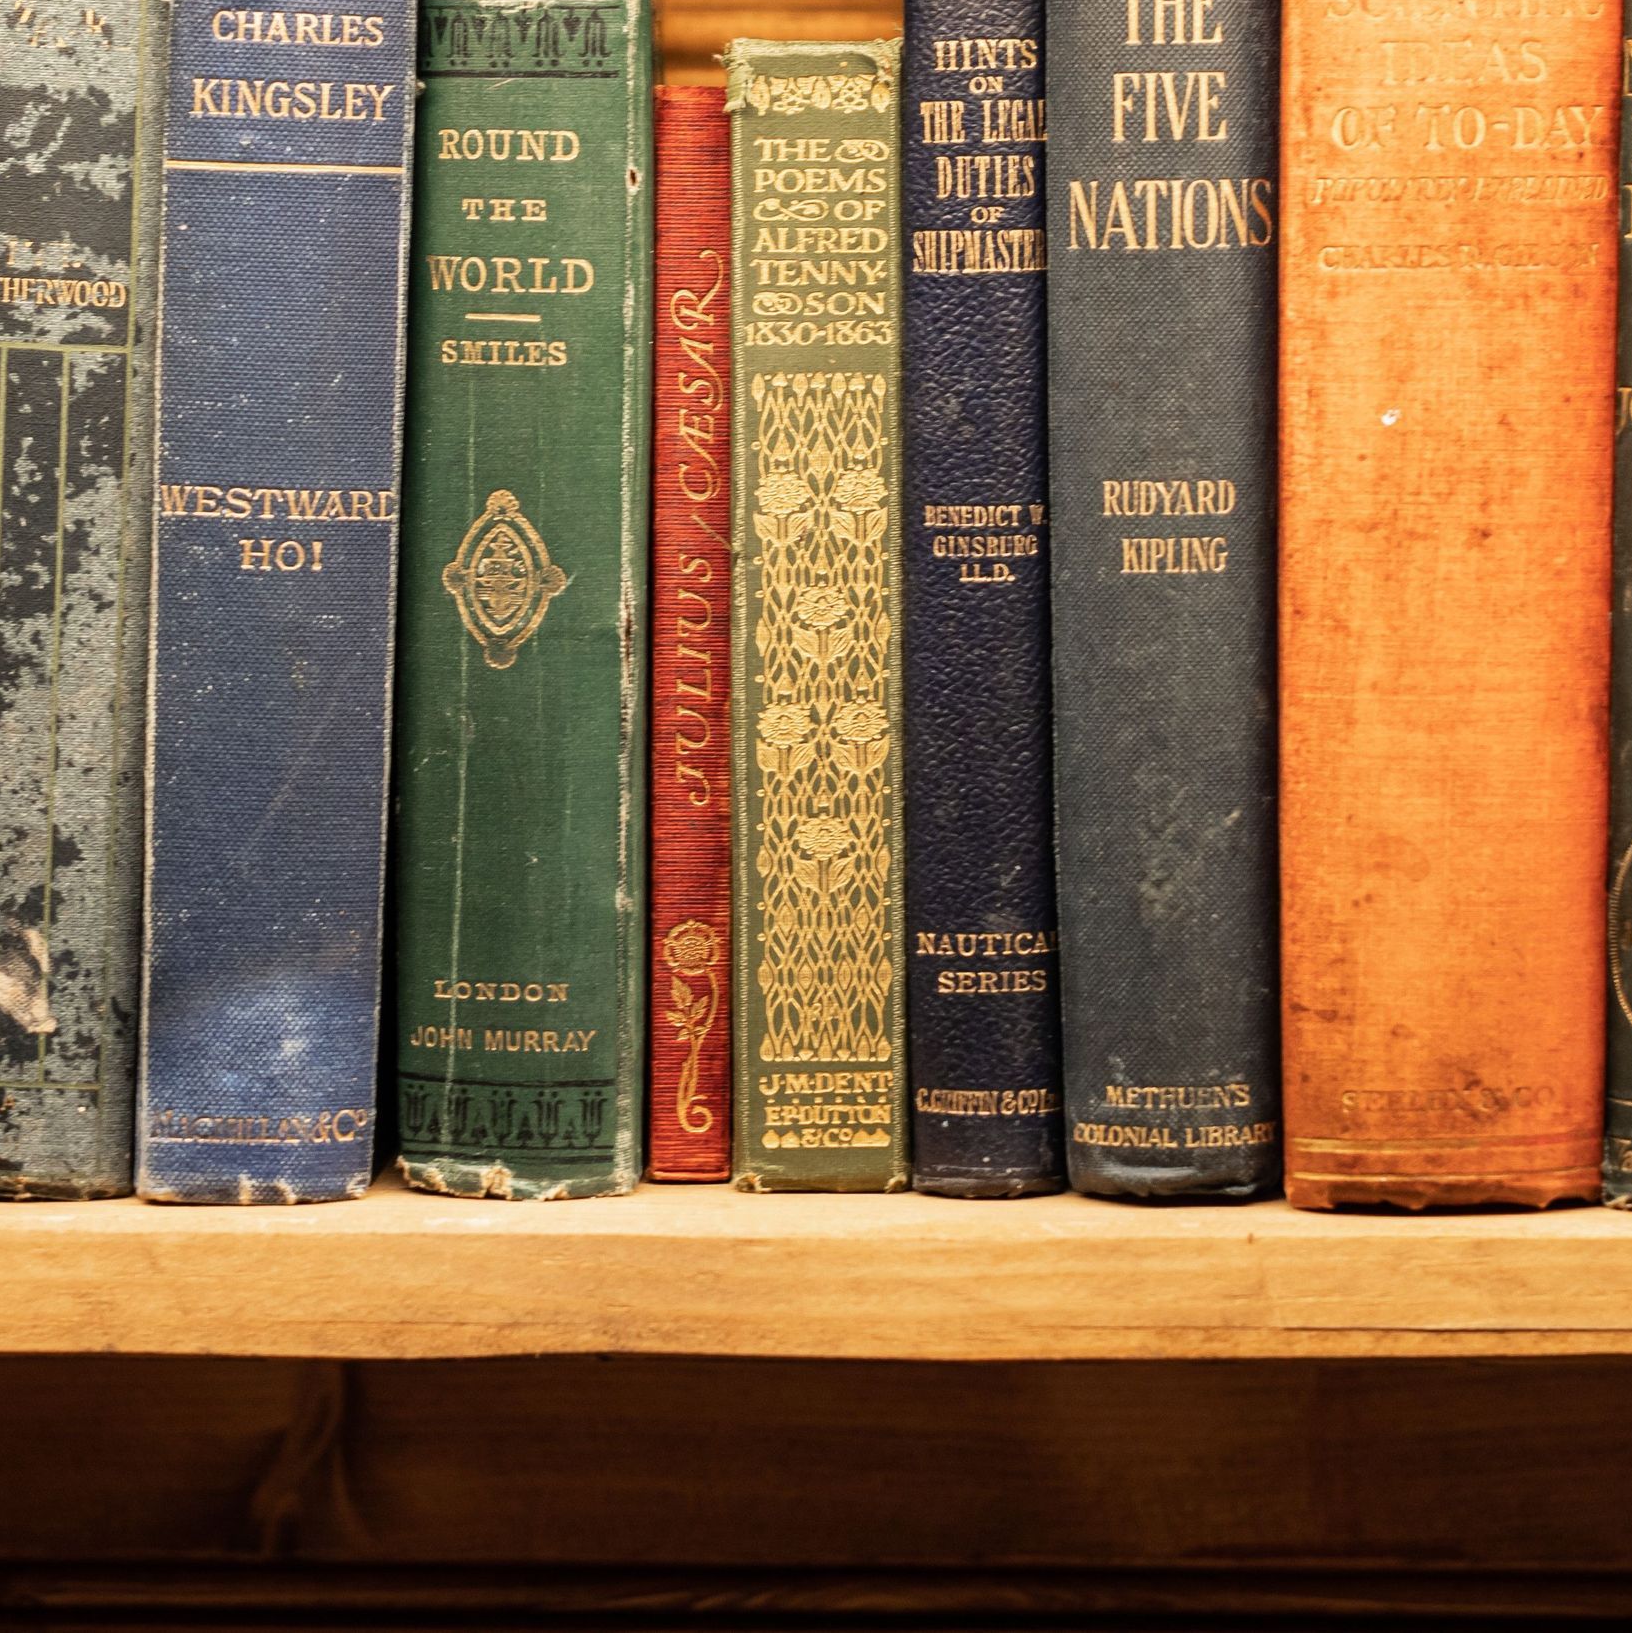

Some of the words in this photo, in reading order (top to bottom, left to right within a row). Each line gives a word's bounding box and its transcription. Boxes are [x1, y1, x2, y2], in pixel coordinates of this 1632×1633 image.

[212, 10, 384, 47] CHARLES
[933, 39, 1038, 70] HINTS
[1379, 36, 1549, 87] IDEAS
[969, 76, 1004, 94] ON
[189, 77, 396, 121] KINGSLEY
[1112, 71, 1228, 143] FIVE
[920, 100, 966, 143] THE
[1330, 105, 1398, 151] OF
[1415, 103, 1607, 151] TO-DAY
[438, 129, 580, 161] ROUND
[754, 139, 832, 162] THE
[754, 168, 887, 194] POEMS
[935, 155, 1036, 198] DUTIES
[462, 198, 547, 221] THE
[834, 200, 886, 222] OF
[970, 206, 1005, 223] OF
[1066, 178, 1272, 250] NATIONS
[751, 227, 888, 254] ALFRED
[427, 255, 595, 294] WORLD
[804, 292, 886, 316] SON
[744, 321, 893, 347] 1830-1863
[441, 339, 567, 366] SMILES
[1103, 479, 1236, 516] RUDYARD
[923, 504, 1023, 527] BENEDICT
[238, 539, 324, 571] HO!
[932, 534, 1039, 558] GINSBURG
[1120, 535, 1229, 574] KIPLING
[673, 553, 714, 808] JULIUS
[433, 979, 569, 1002] LONDON
[937, 969, 1048, 994] SERIES
[410, 1026, 473, 1050] JOHN
[484, 1029, 597, 1052] MURRAY
[1001, 1090, 1017, 1114] &
[1103, 1082, 1252, 1109] METHUEN'S
[312, 1109, 334, 1144] &
[1073, 1121, 1178, 1149] COLONIAL
